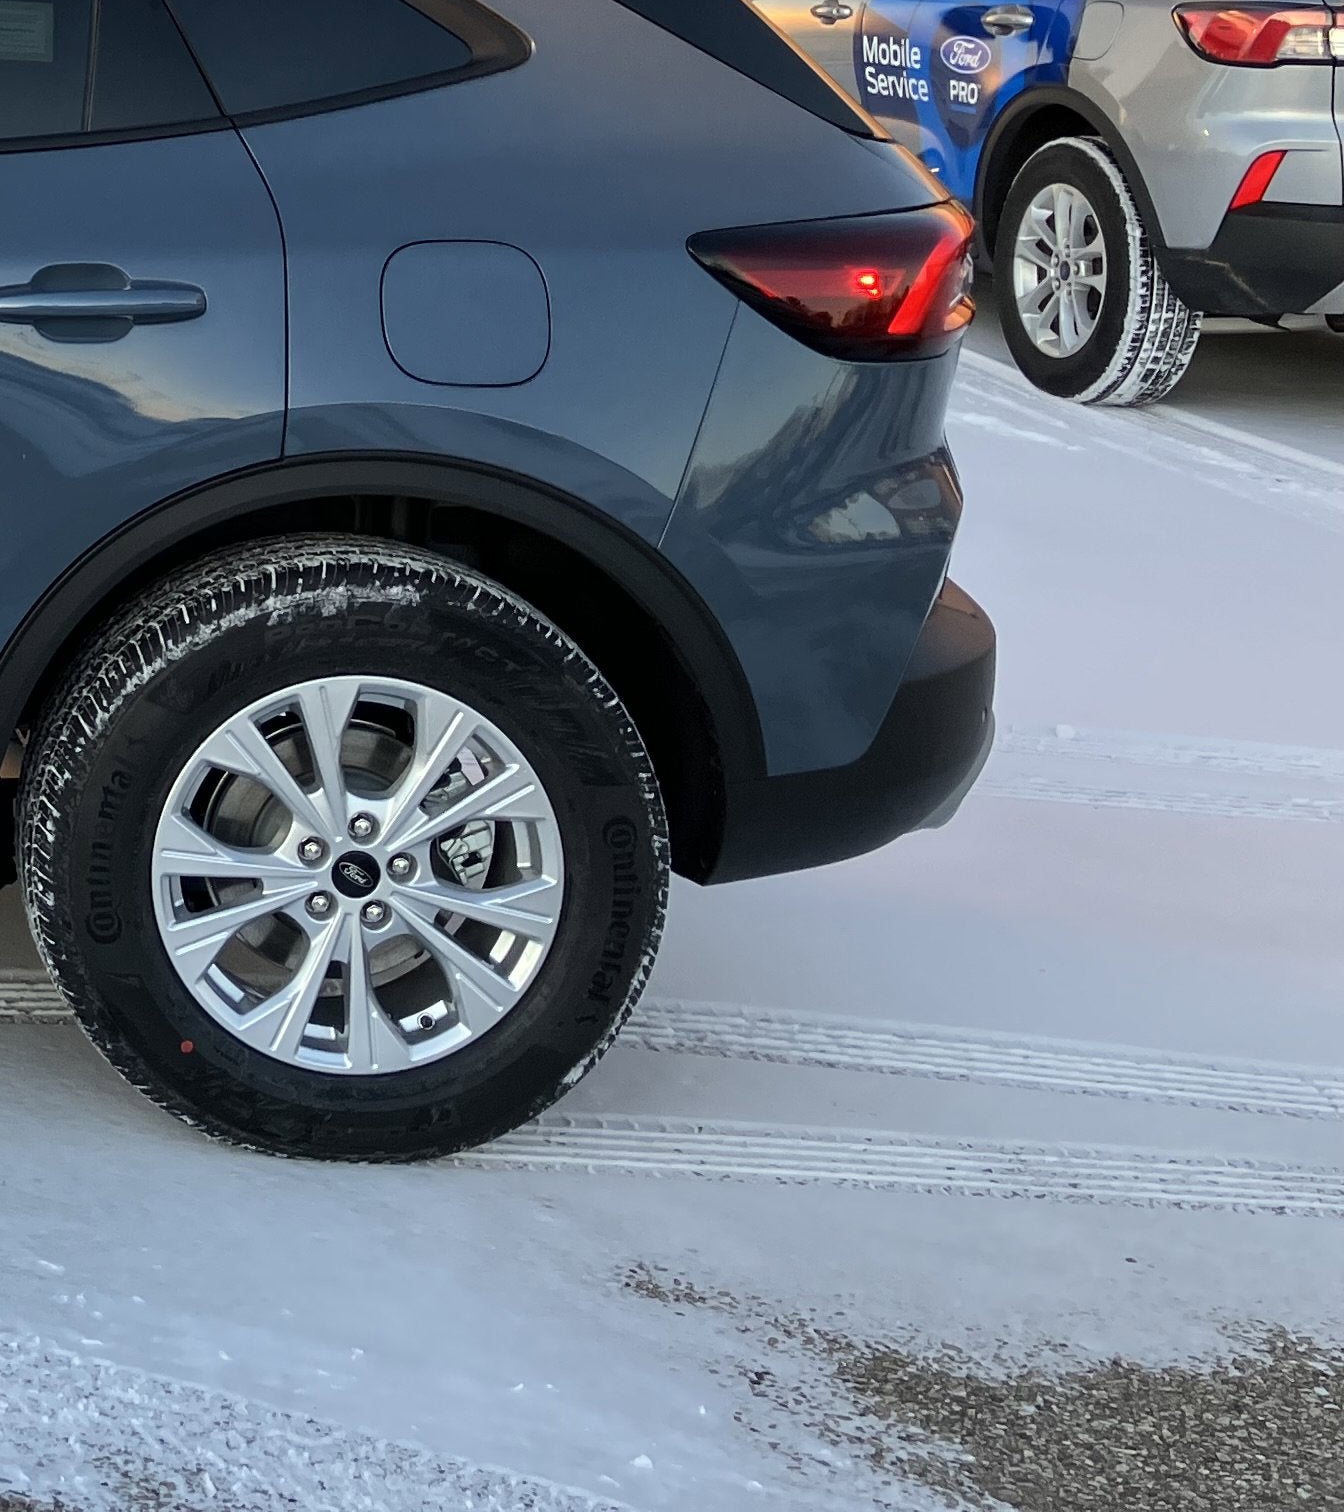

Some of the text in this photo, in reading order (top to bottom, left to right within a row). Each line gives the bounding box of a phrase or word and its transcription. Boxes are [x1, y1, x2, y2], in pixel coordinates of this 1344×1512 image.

[862, 34, 921, 70] Mobile
[950, 40, 981, 68] Ford
[864, 65, 929, 103] Service
